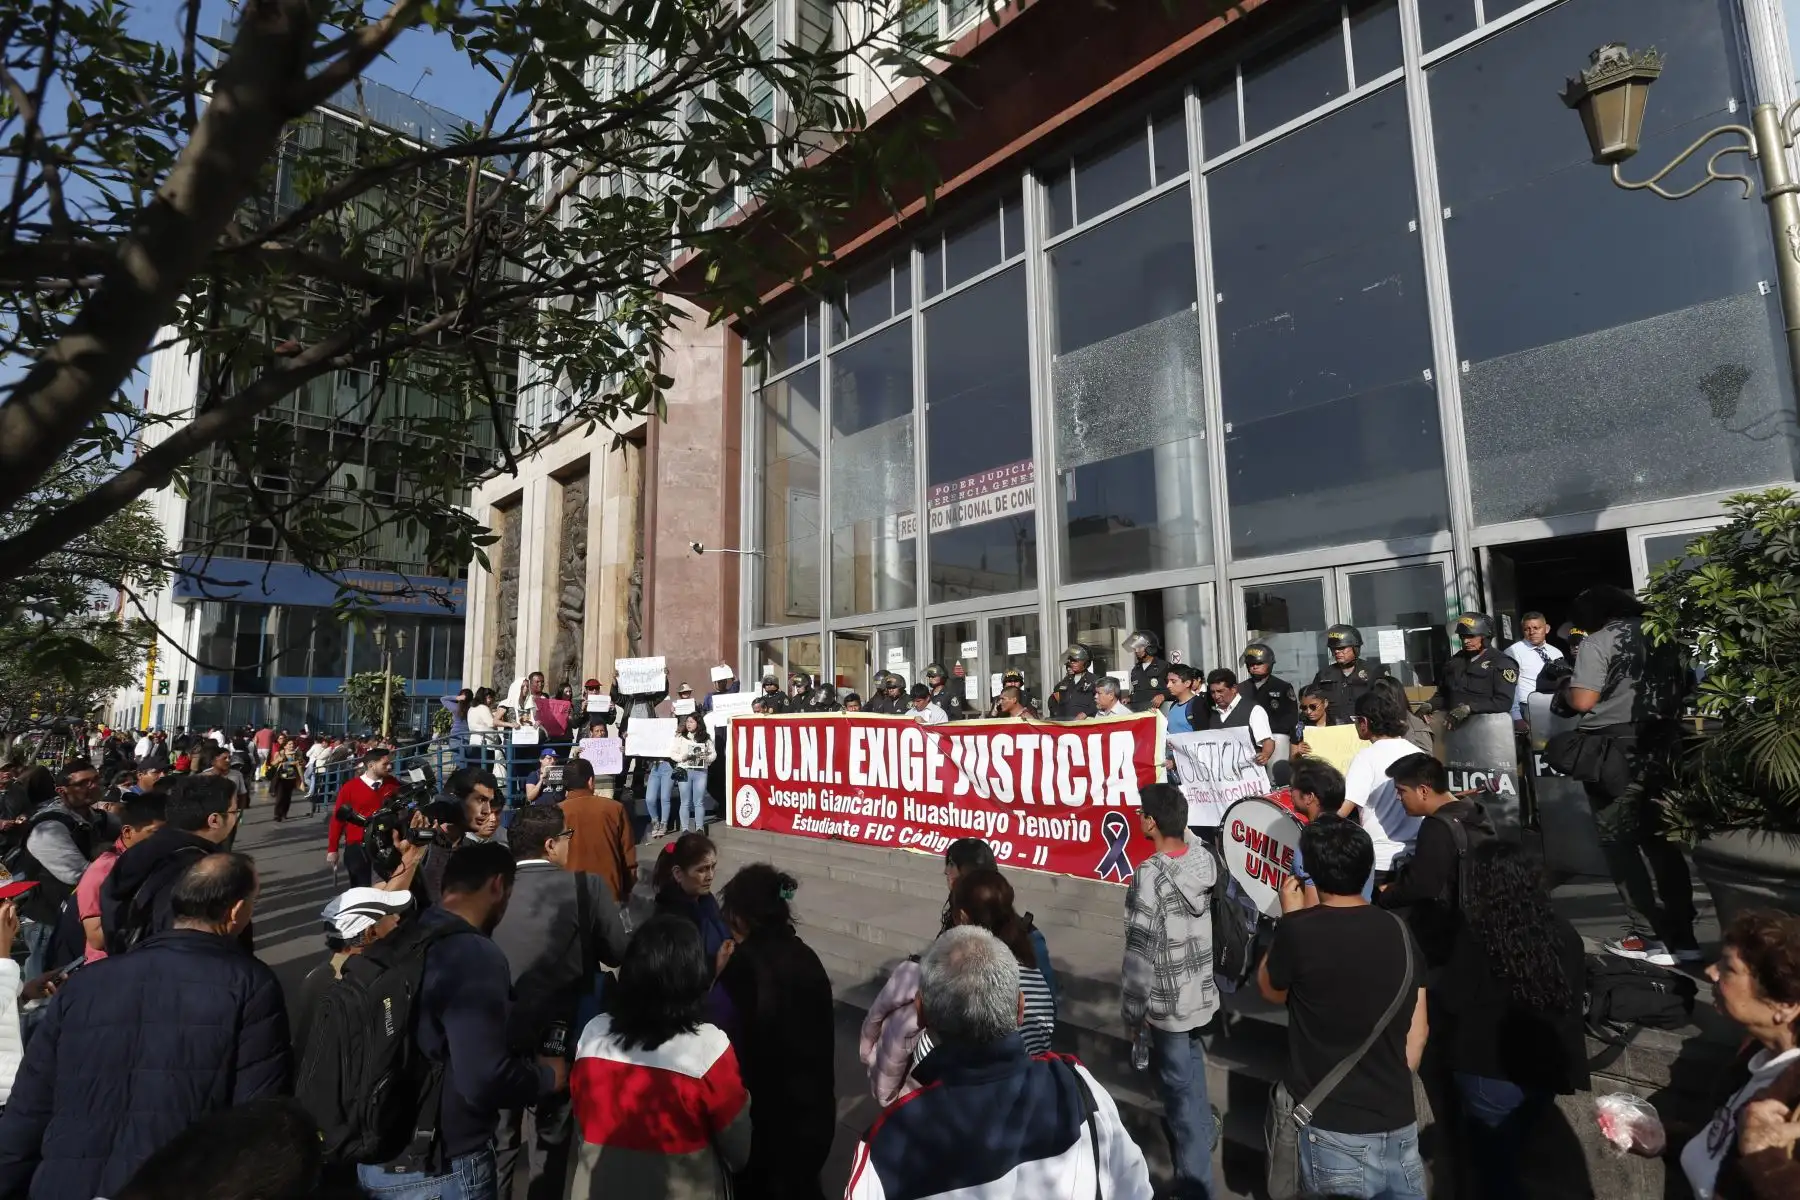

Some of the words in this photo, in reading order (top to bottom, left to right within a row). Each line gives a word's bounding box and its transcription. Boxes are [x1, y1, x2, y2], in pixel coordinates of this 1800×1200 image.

[935, 478, 975, 496] PODER
[946, 499, 992, 525] NACIONAL
[995, 494, 1008, 512] DE
[738, 726, 768, 779] LA
[774, 726, 842, 784] U.N.I.
[849, 726, 945, 794] EXIGE
[950, 731, 1142, 807] JUSTICIA
[1181, 741, 1260, 783] JUSTICIA
[768, 785, 816, 814] Joseph
[820, 788, 898, 819] Giancarlo
[903, 797, 1009, 837] Huashuayo
[1013, 810, 1091, 842] Tenorio
[791, 814, 860, 838] Estudiante
[864, 823, 896, 842] FIC
